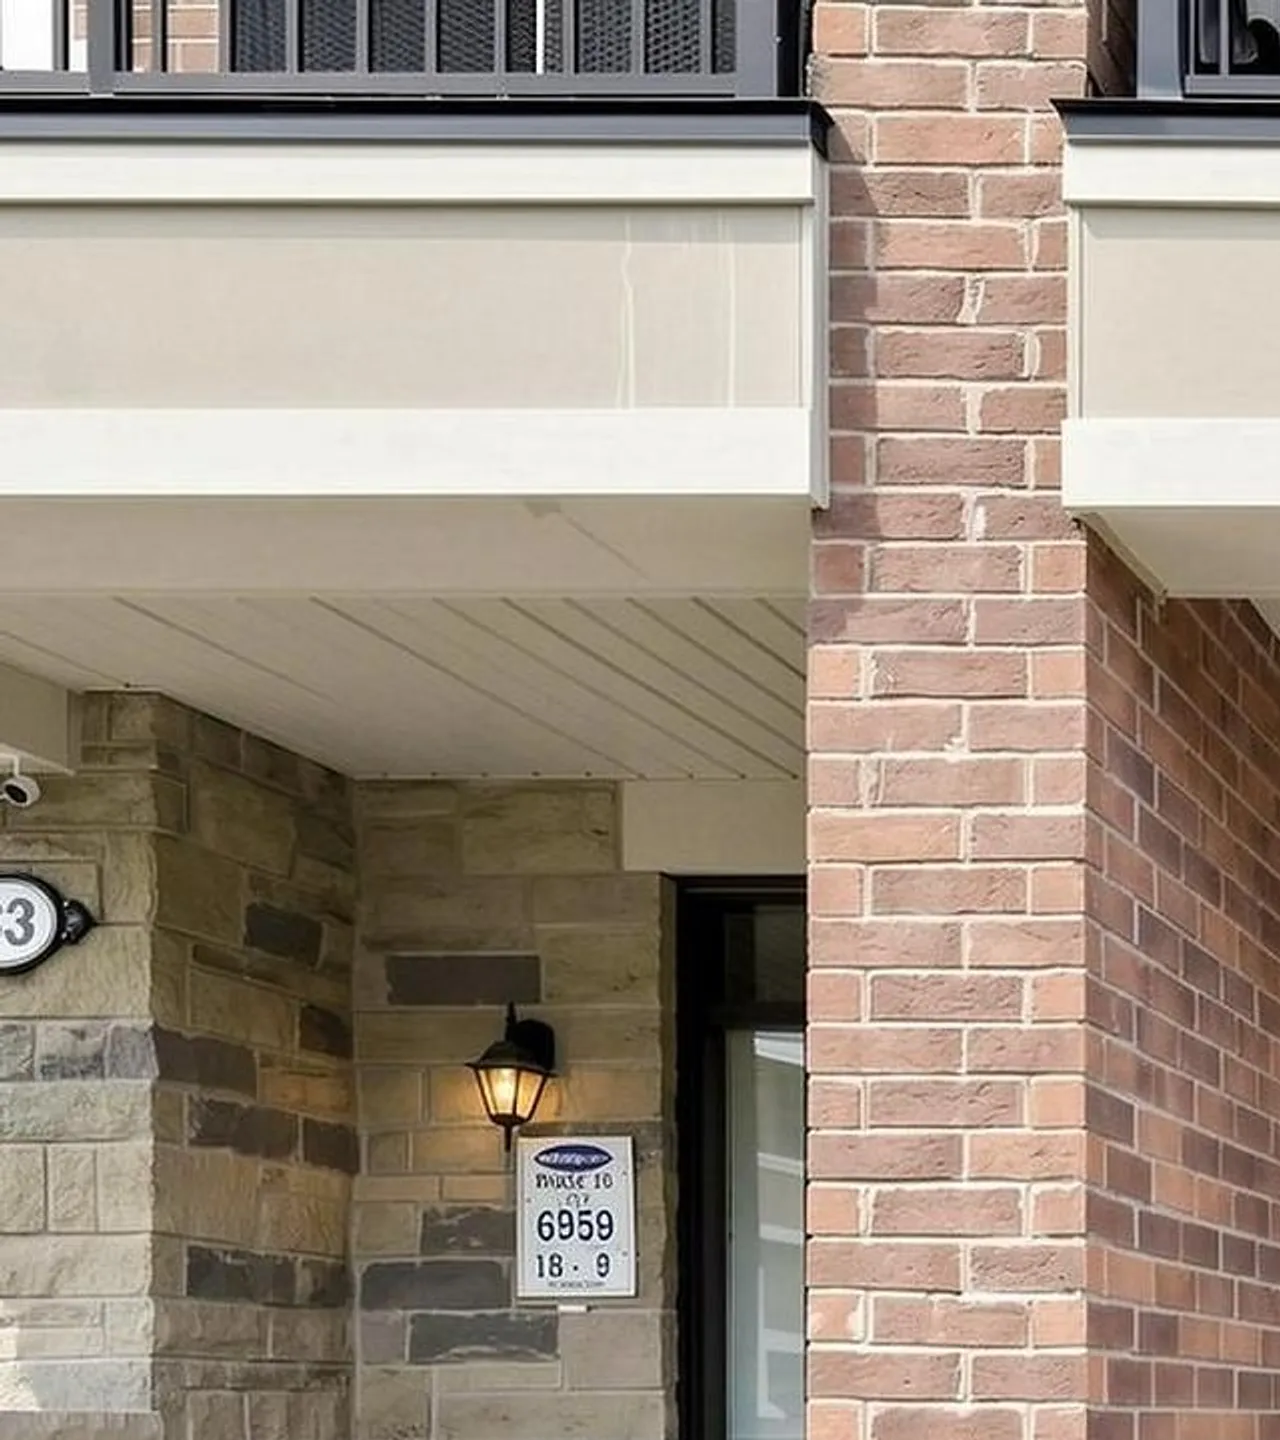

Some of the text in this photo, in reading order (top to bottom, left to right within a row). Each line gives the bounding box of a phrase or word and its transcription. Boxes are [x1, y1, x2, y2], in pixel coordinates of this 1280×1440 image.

[0, 898, 35, 947] 3
[537, 1209, 614, 1242] 6959
[536, 1252, 563, 1278] 18
[596, 1252, 610, 1278] 9
